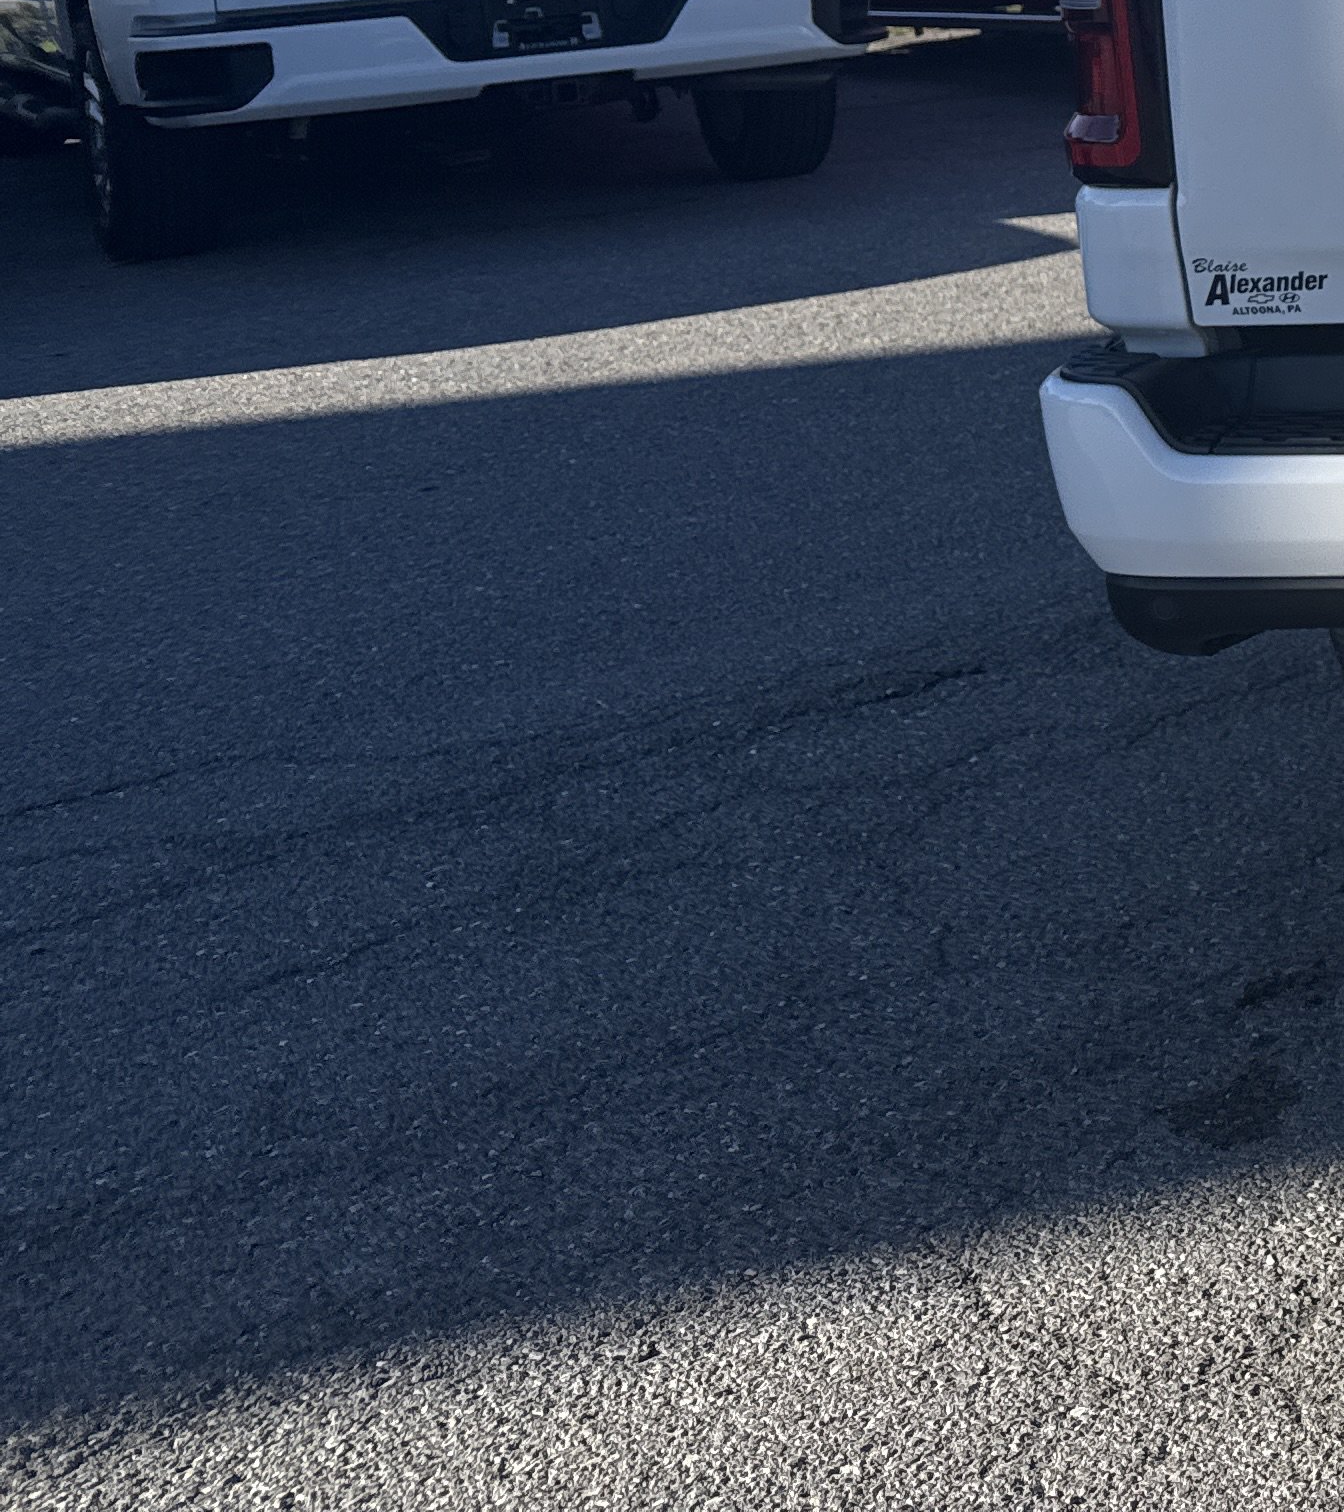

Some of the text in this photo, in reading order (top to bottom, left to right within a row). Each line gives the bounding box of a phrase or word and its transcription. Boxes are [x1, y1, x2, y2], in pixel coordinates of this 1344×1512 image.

[1192, 257, 1248, 273] Blaise
[1204, 271, 1328, 306] Alexander
[1288, 304, 1302, 313] PA
